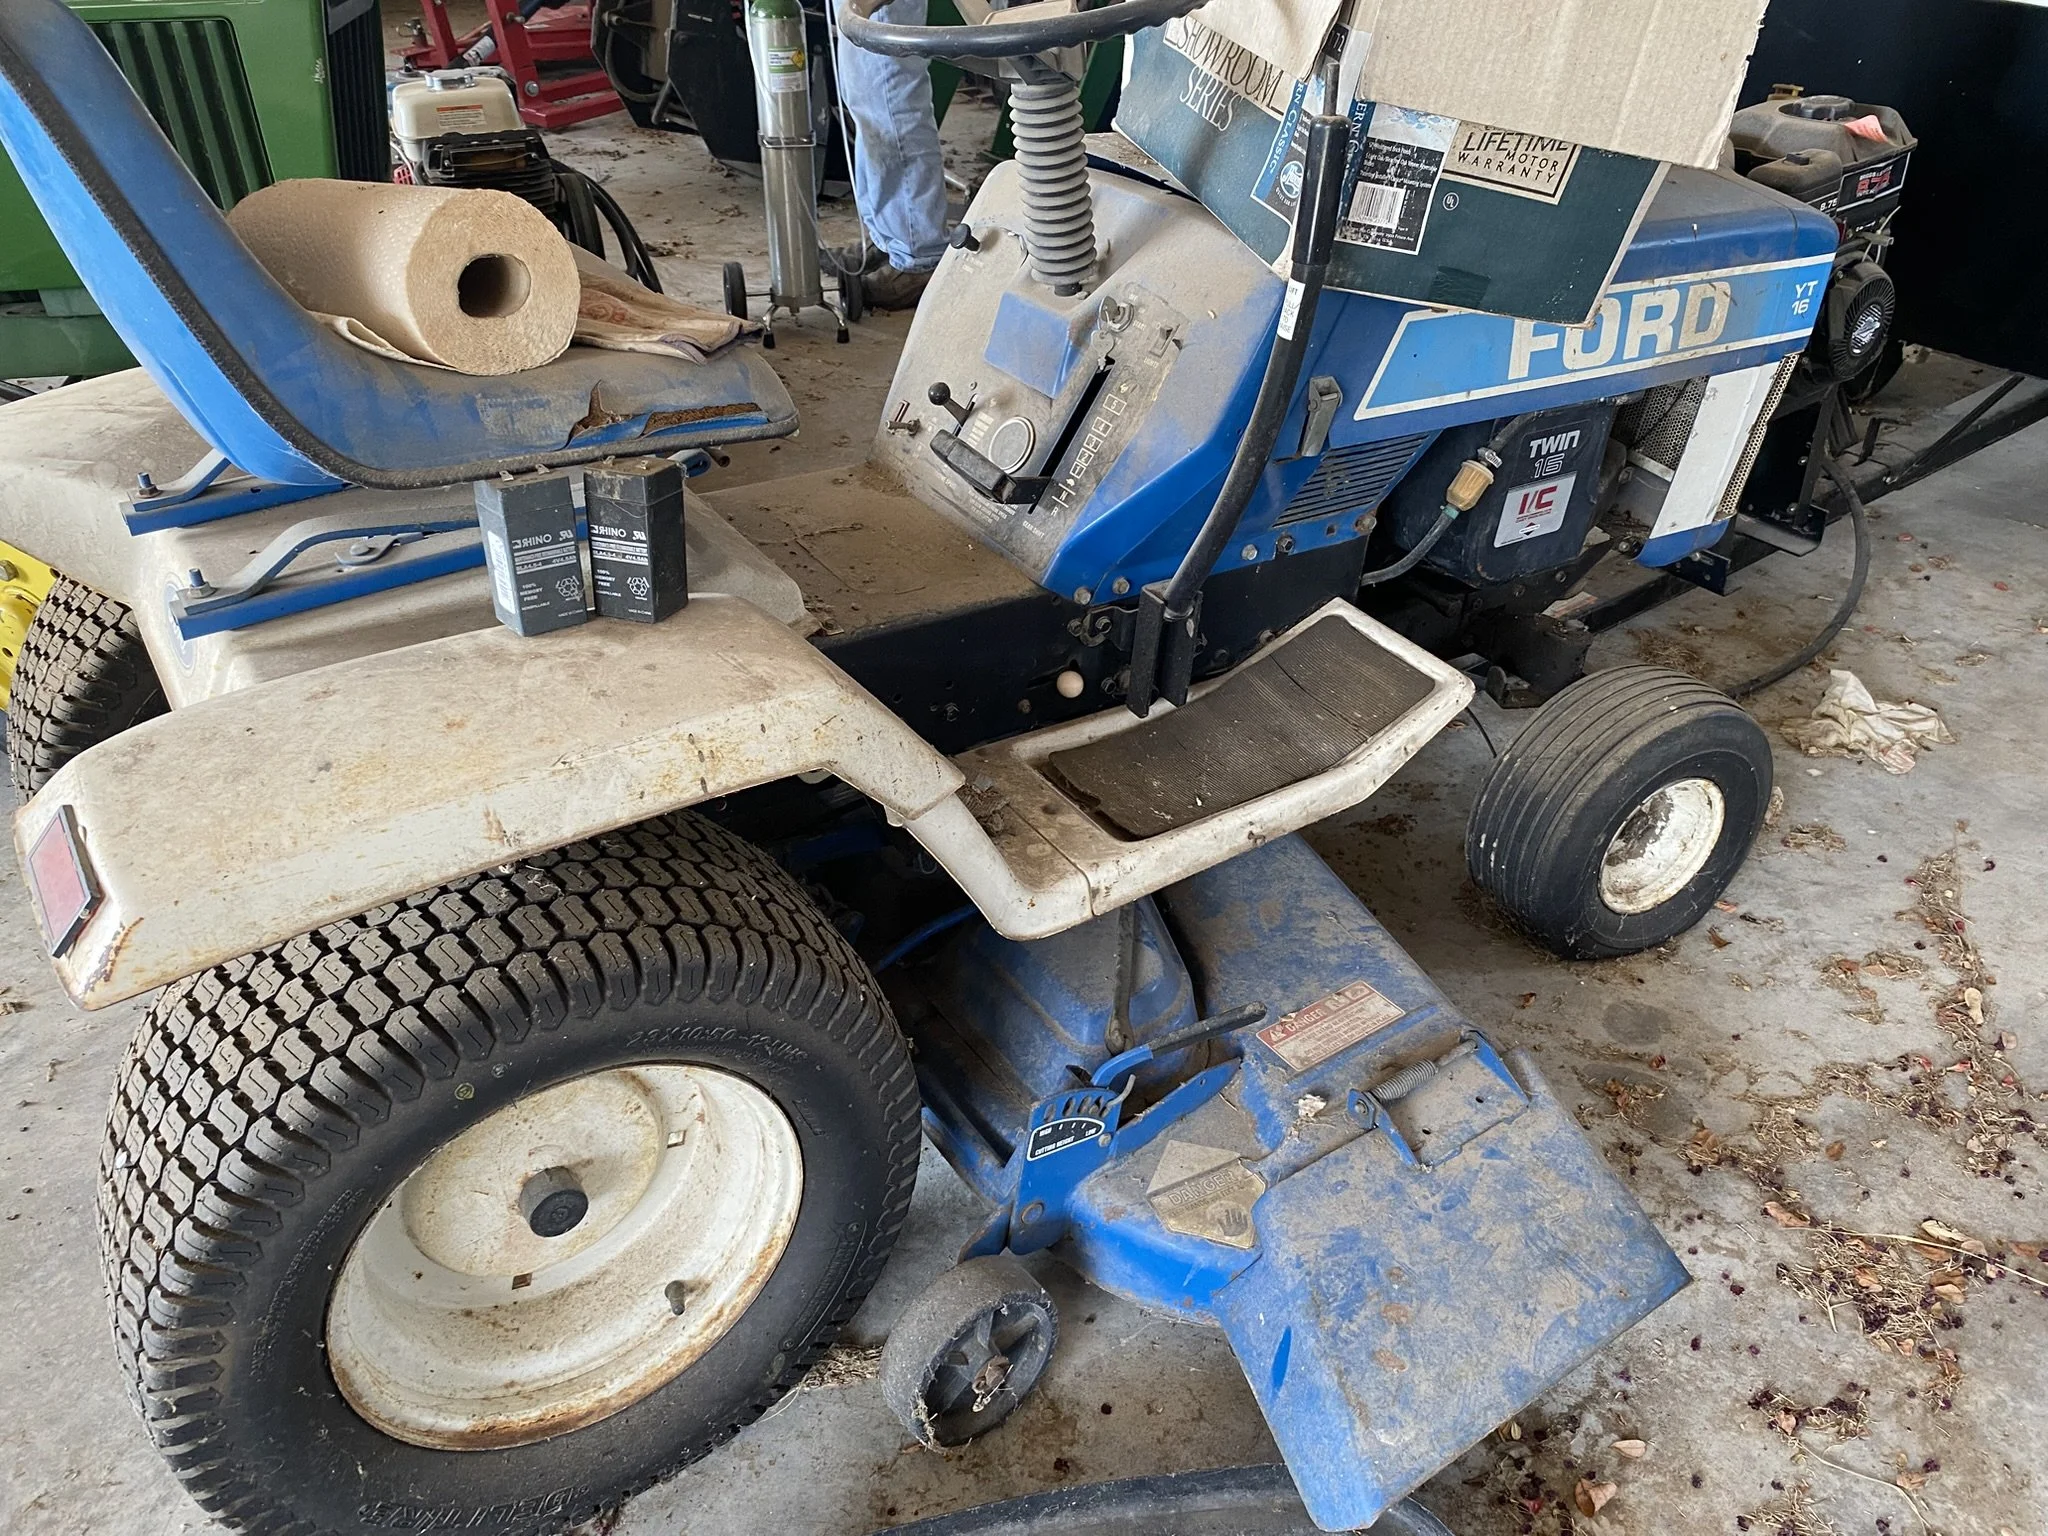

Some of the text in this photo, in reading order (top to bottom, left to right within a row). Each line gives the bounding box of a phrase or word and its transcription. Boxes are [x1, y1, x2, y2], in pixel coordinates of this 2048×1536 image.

[1177, 16, 1284, 108] SHOWROOM
[1180, 66, 1244, 131] SERIES
[1270, 110, 1297, 174] CLASSIC
[1463, 132, 1568, 151] LIFETIME
[1458, 152, 1555, 183] WARRANTY
[1505, 150, 1558, 171] MOTOR
[1795, 280, 1818, 298] YT
[1792, 298, 1809, 315] 16
[1508, 281, 1731, 380] FORD
[1530, 430, 1580, 458] TWIN
[1534, 453, 1564, 478] 16
[1060, 491, 1068, 500] N
[1051, 506, 1059, 517] R
[1286, 1007, 1327, 1032] DANGER
[1035, 1136, 1074, 1155] CUTTING HEIGHT
[1168, 1168, 1235, 1206] DANGER
